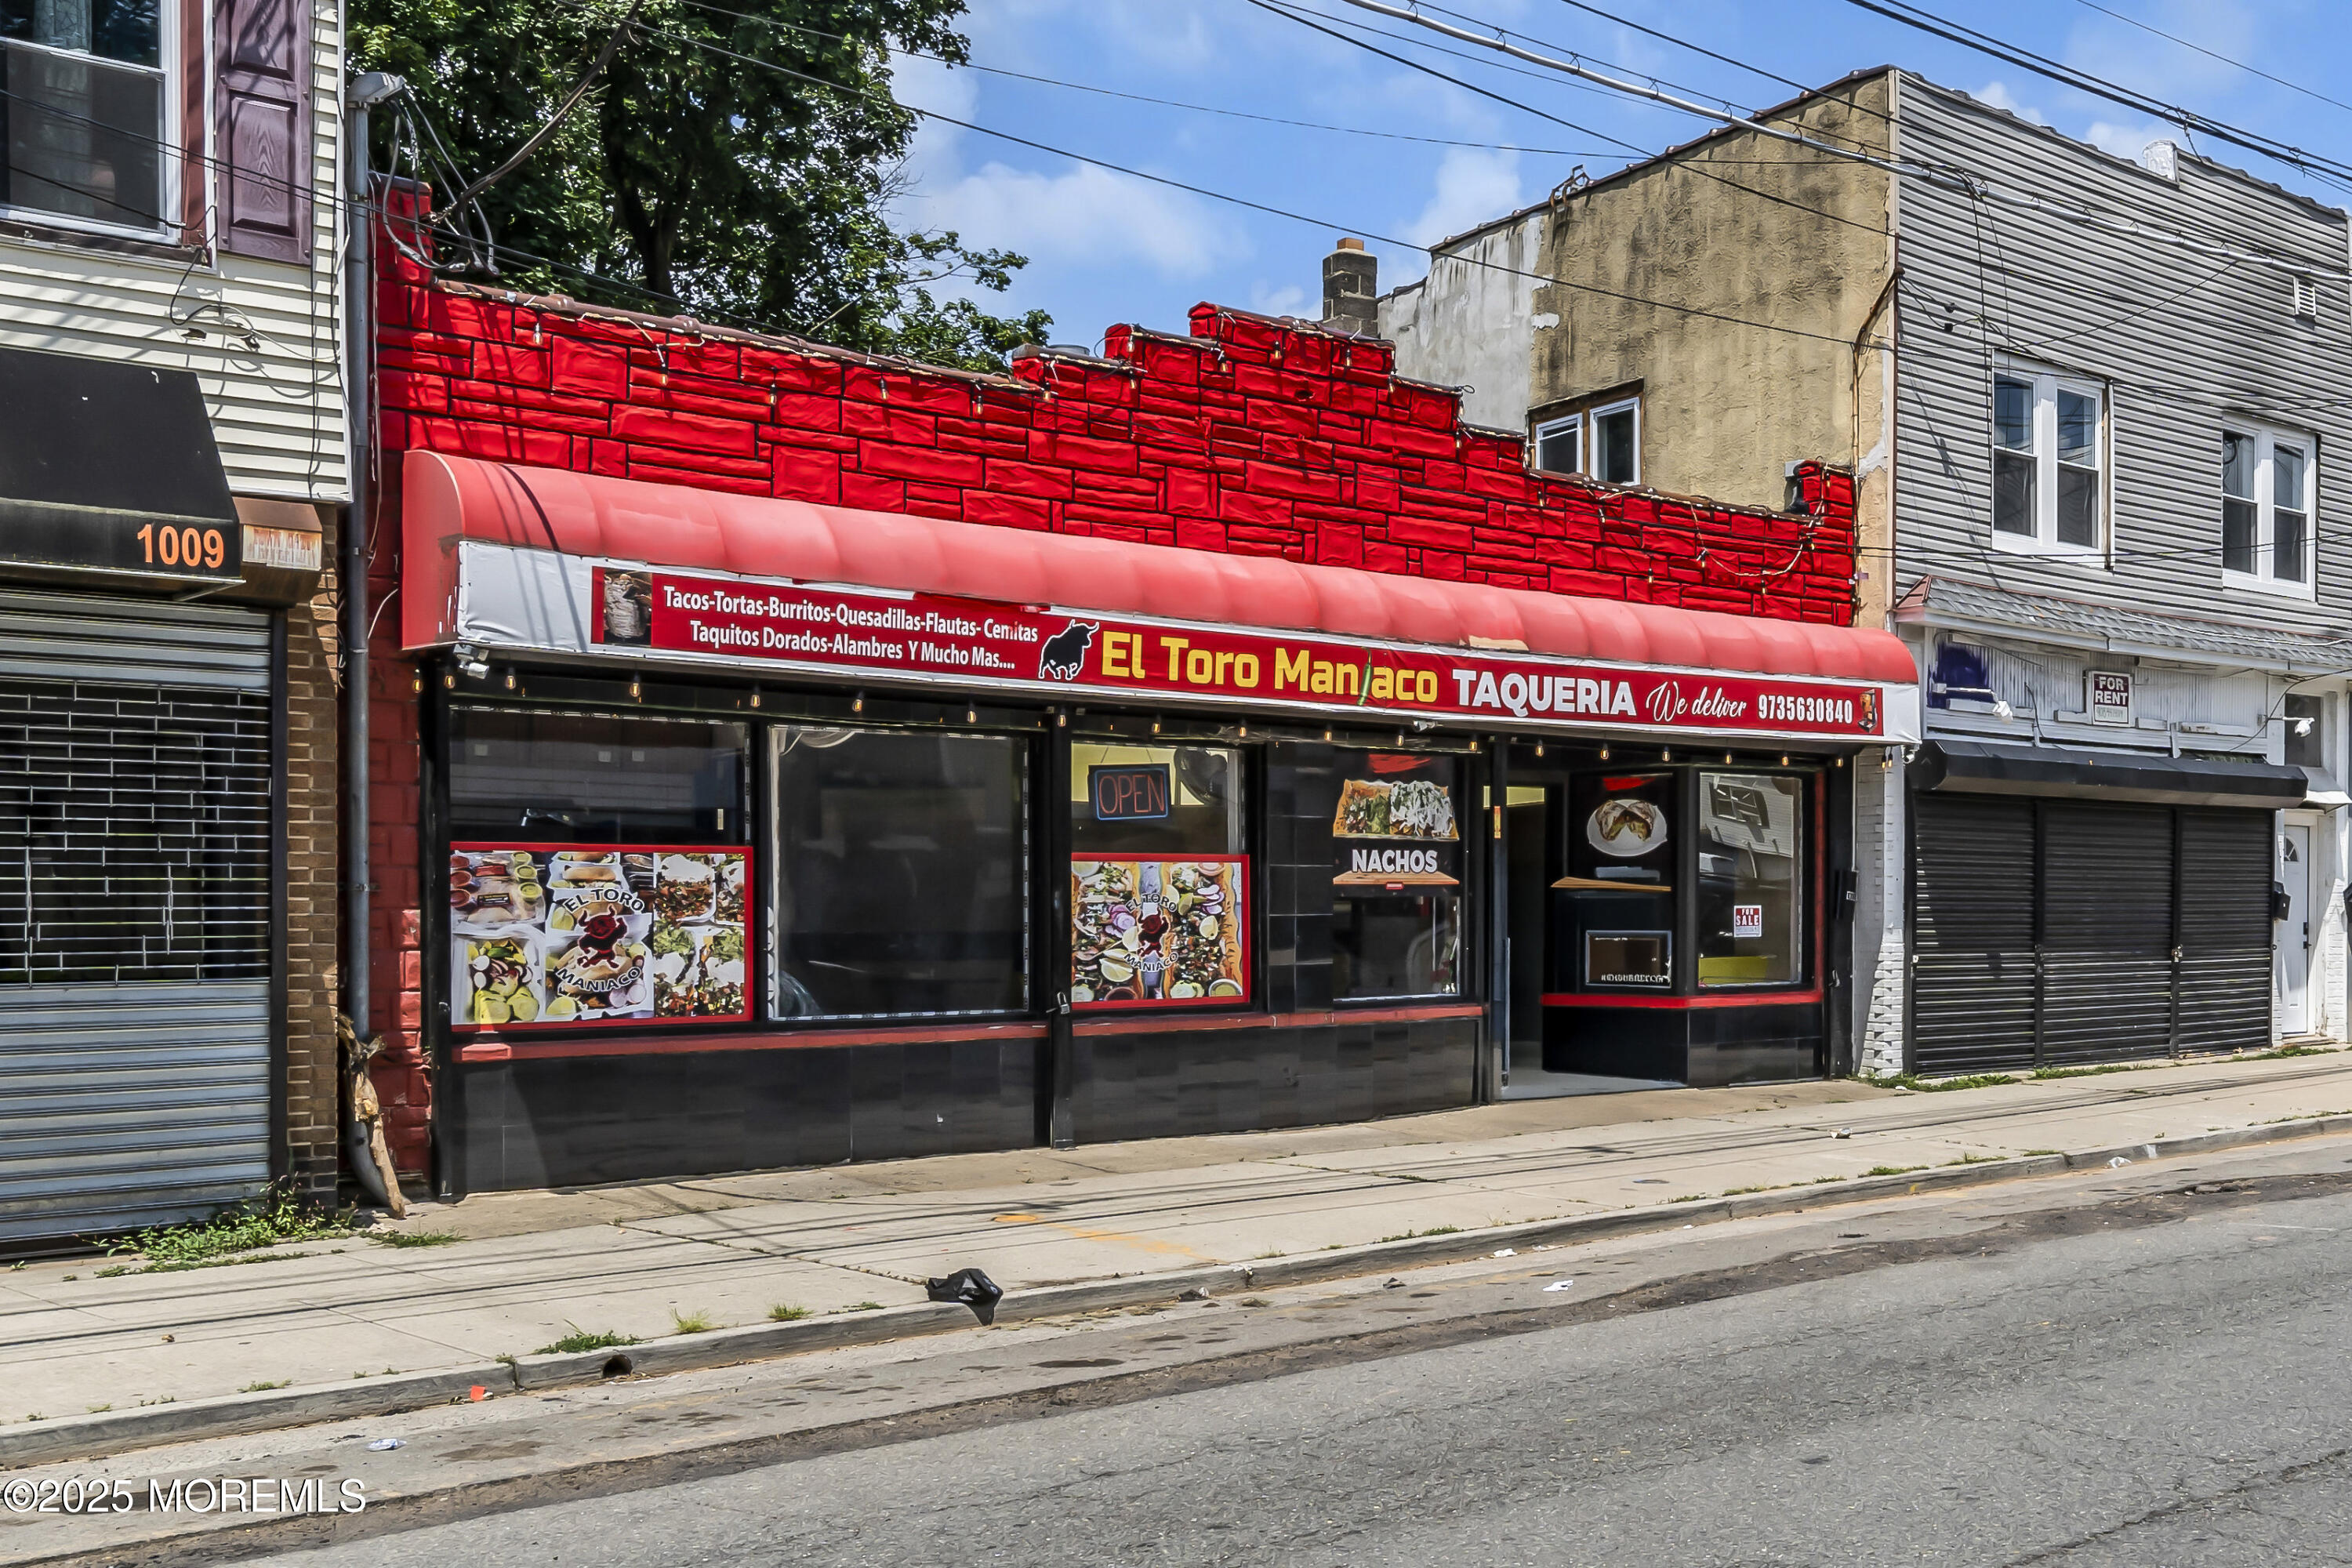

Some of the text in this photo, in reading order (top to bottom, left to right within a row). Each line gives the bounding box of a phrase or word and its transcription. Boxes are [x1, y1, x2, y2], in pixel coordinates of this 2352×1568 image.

[137, 524, 224, 568] 1009
[690, 620, 759, 648] Taquitos
[763, 626, 902, 659] Dorados-Alambres
[908, 641, 919, 660] Y
[921, 642, 969, 665] Mucho
[984, 619, 1038, 642] Cemitas
[1102, 630, 1146, 681] El
[1160, 636, 1260, 688] Toro
[1452, 669, 1637, 717] TAQUERIA
[2099, 677, 2124, 691] FOR
[1646, 681, 1747, 722] We deliver
[1758, 694, 1853, 724] 9735630840
[2095, 691, 2128, 705] RENT
[1098, 775, 1164, 815] OPEN
[1352, 849, 1438, 873] NACHOS
[563, 888, 644, 913] EL TORO
[1126, 894, 1177, 912] EL TORO
[1736, 915, 1759, 926] SALE
[1123, 952, 1178, 971] MANIACO
[556, 967, 641, 992] MANIACO
